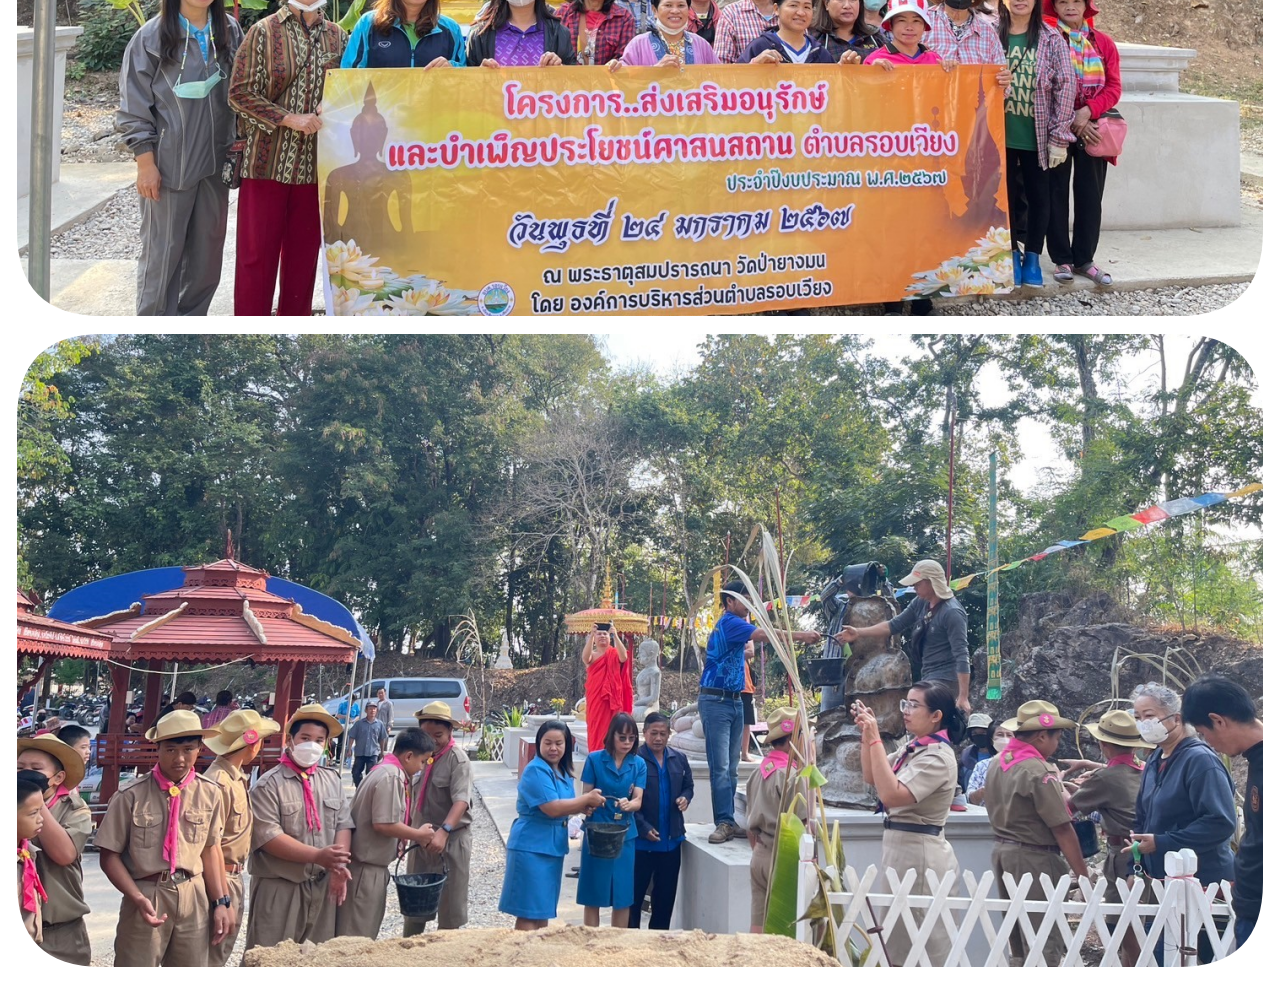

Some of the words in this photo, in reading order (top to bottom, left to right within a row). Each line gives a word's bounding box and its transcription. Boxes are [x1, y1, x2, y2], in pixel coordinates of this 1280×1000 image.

[388, 128, 793, 167] และบำเพ็ญประโยชน์ศาสนสถาน
[804, 126, 957, 156] ตำบลรอบเวียง
[727, 170, 861, 191] ประจำปีงบประมาณ
[866, 169, 947, 186] พ.ศ.๒๕๖๗
[509, 199, 618, 251] วันพุธที่
[622, 211, 668, 240] ๒๔
[543, 269, 562, 284] ณ
[568, 259, 731, 287] พระธาตุสมปรารถนา
[736, 253, 826, 275] วัดป่ายางมน
[532, 293, 564, 313] โดย
[570, 280, 832, 312] องค์การบริหารส่วนตำบลรอบเวียง
